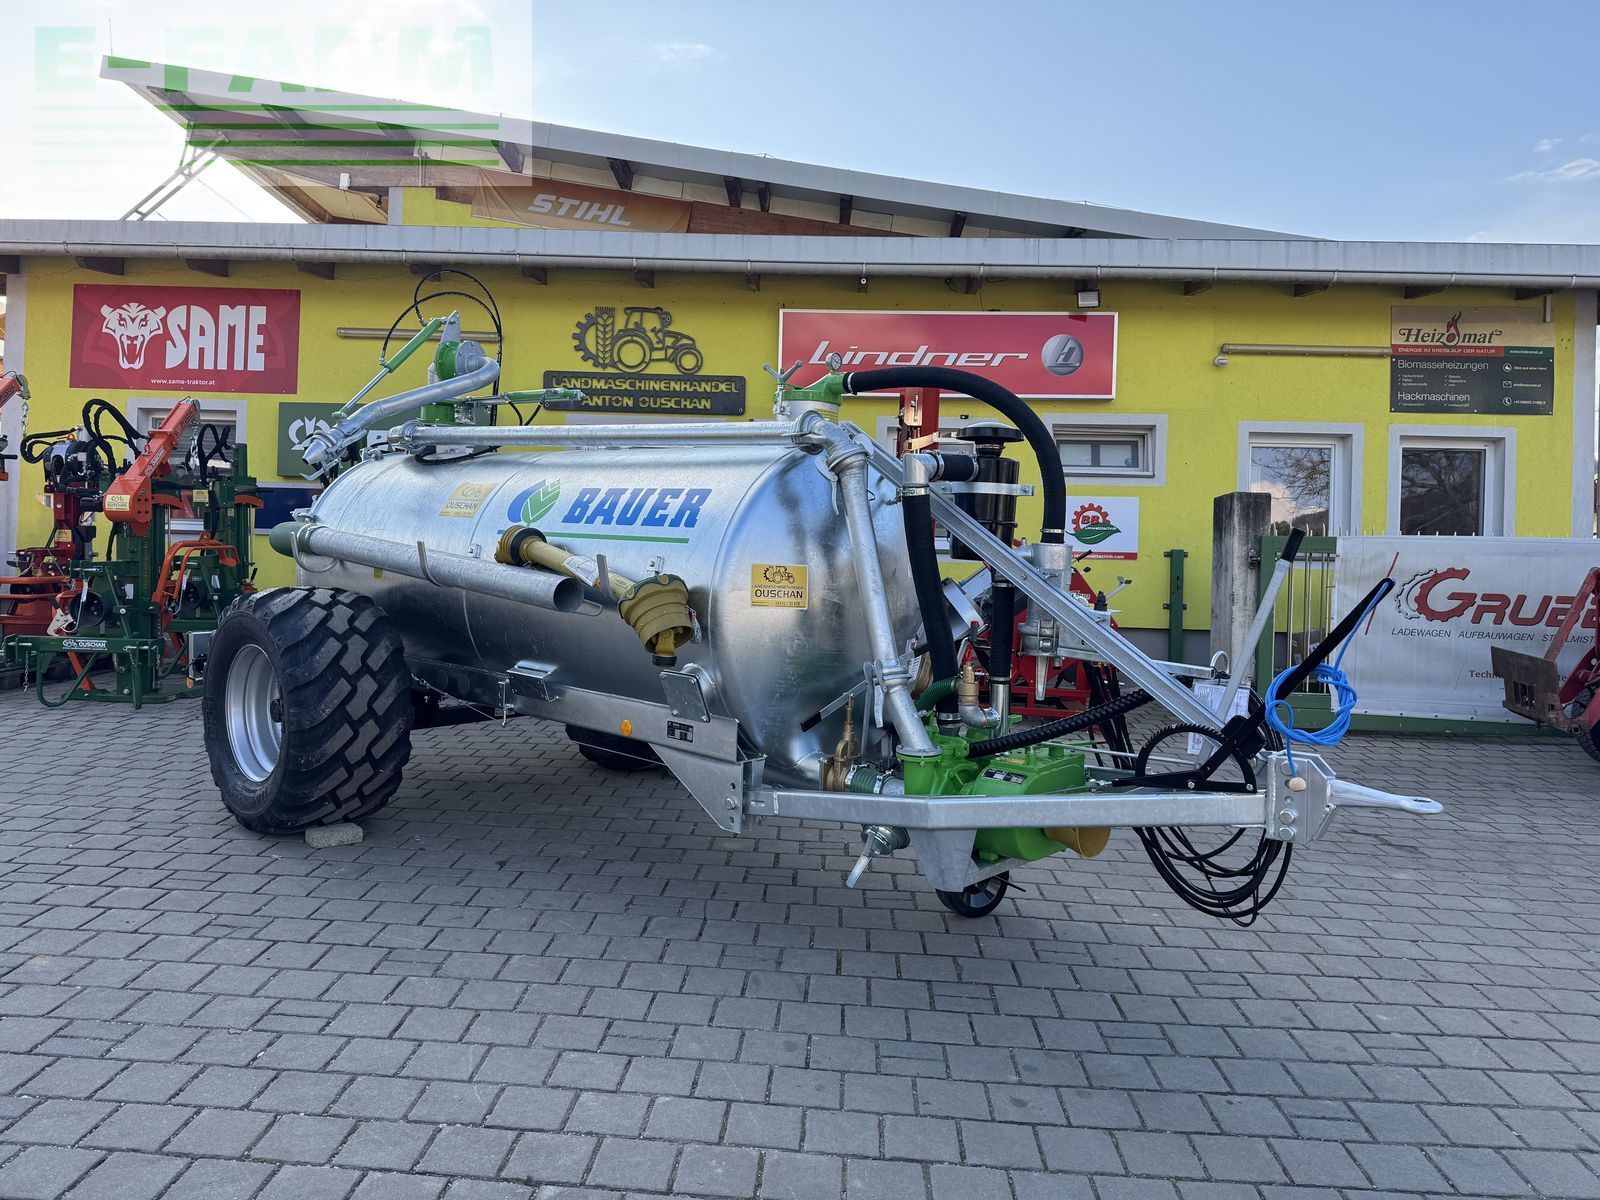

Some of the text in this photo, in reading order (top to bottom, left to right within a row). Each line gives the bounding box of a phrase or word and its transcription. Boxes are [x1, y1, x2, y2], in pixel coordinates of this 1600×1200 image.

[527, 193, 631, 227] STIHL
[165, 304, 267, 372] SAME
[808, 340, 1029, 367] Lindner
[1397, 359, 1489, 371] Biomasseheizungen
[150, 377, 216, 386] www.same-traktor.at
[552, 375, 740, 393] LANDMASCHINENHANDEL
[582, 394, 712, 410] ANTON OUSCHAN
[1397, 391, 1471, 401] Hackmaschinen
[561, 487, 713, 528] BAUER
[754, 589, 803, 599] OUSCHAN
[1391, 628, 1452, 638] LADEWAGEN
[1458, 630, 1535, 641] AUFBAUWAGEN
